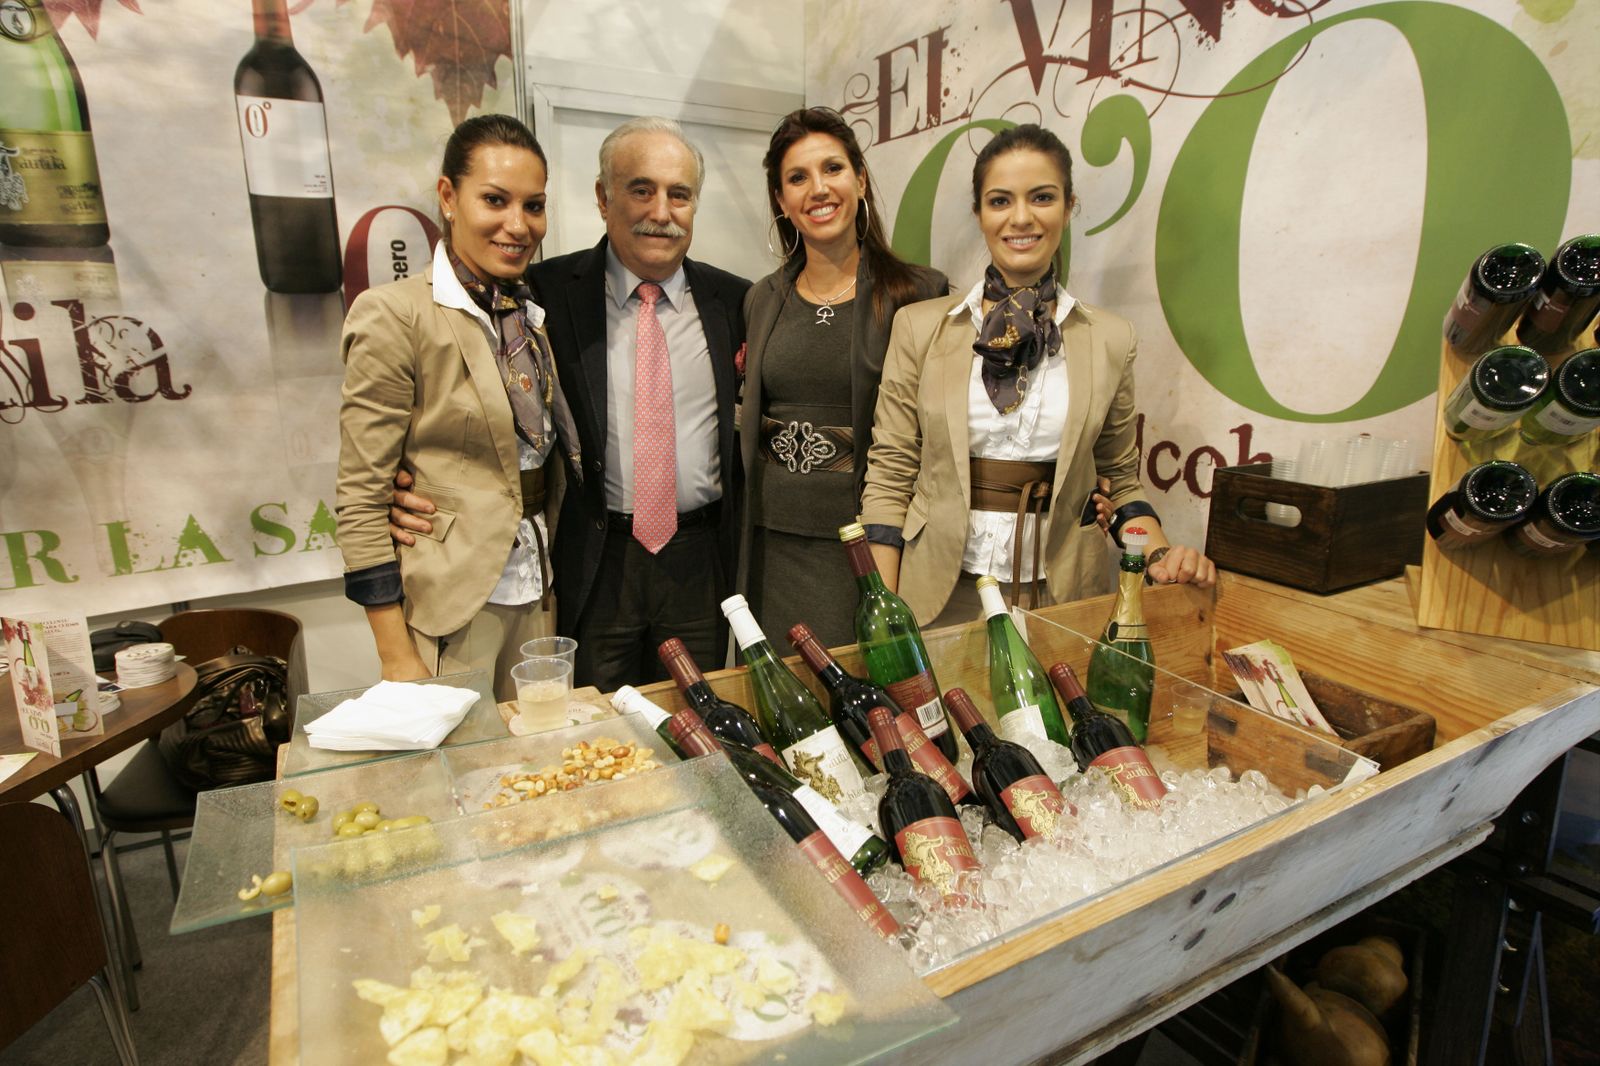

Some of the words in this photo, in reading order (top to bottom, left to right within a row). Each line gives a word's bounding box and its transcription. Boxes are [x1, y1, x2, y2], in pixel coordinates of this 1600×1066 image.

[868, 26, 974, 147] EL
[1008, 0, 1334, 97] VIN
[97, 513, 234, 578] LA
